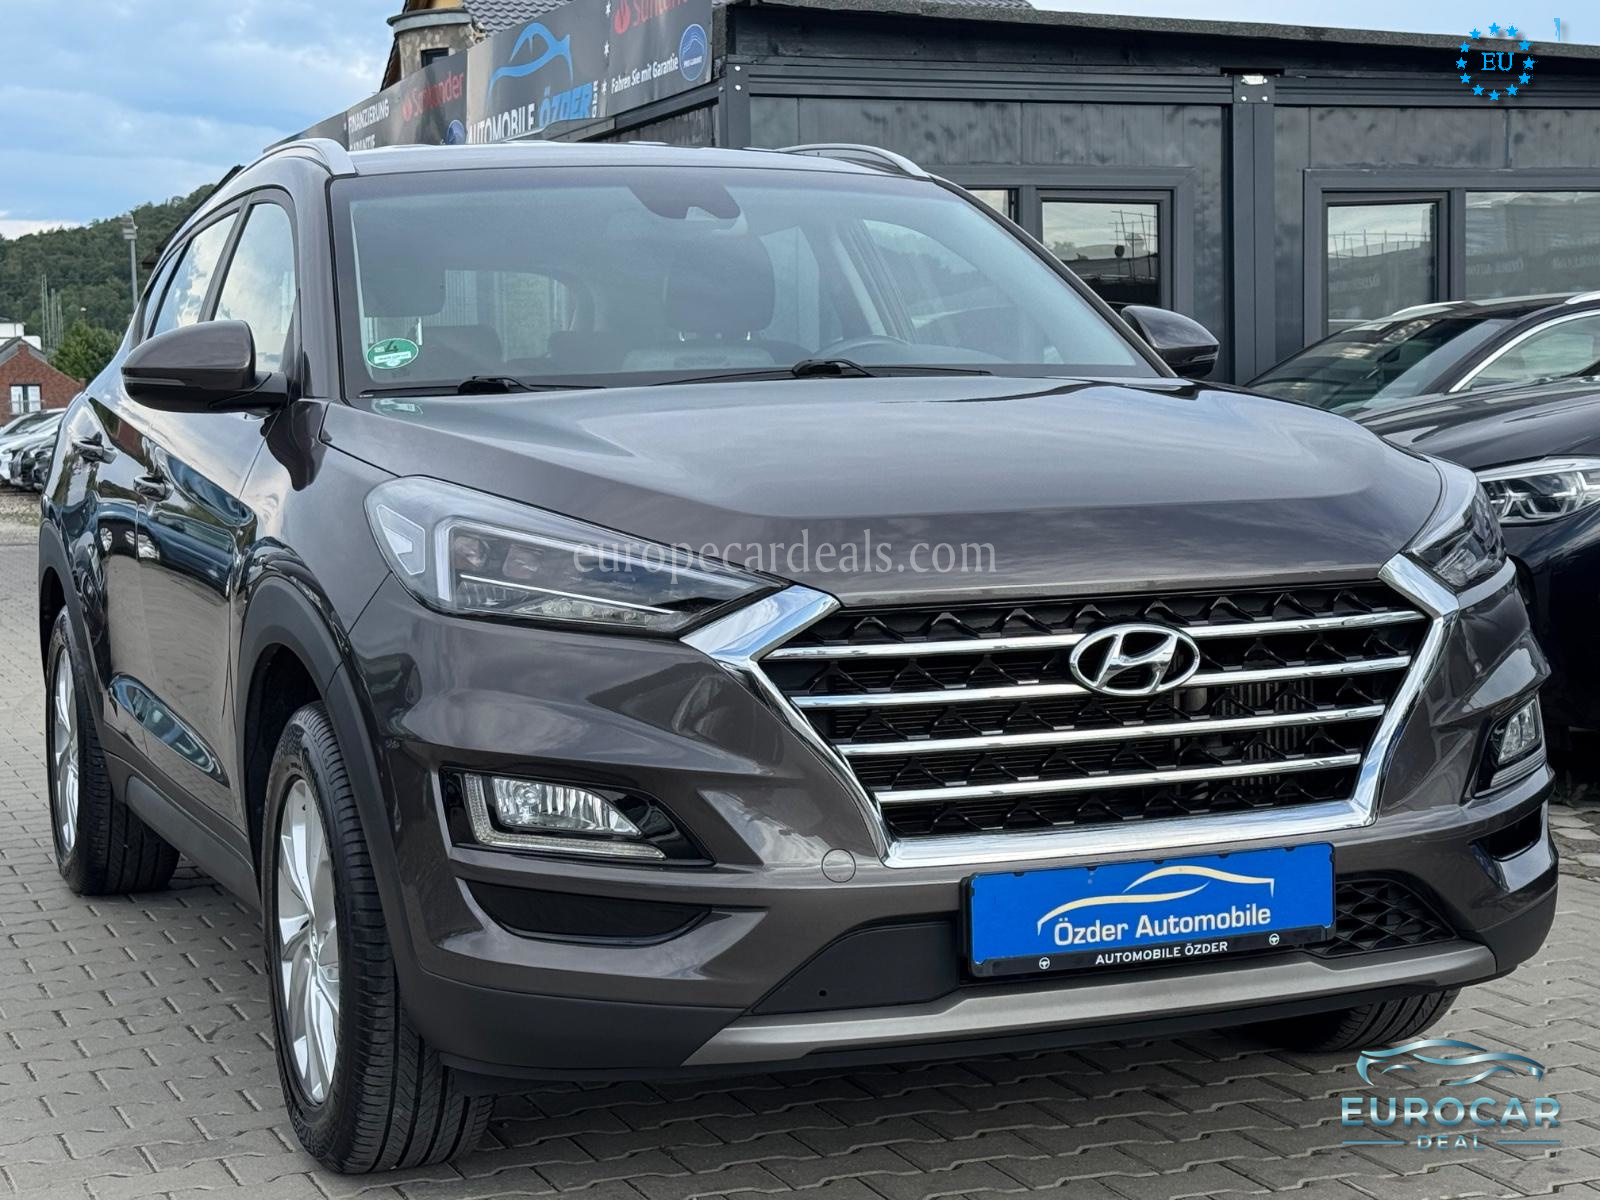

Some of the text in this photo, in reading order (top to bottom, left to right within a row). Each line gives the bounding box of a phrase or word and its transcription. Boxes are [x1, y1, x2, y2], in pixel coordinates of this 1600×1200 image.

[611, 74, 631, 94] Fahren
[631, 68, 641, 86] Sie
[641, 63, 652, 83] mit
[652, 53, 679, 78] Garantie
[348, 98, 390, 133] FINANZIERUNG
[468, 103, 535, 144] AUTOMOBILE
[1054, 903, 1271, 946] Özder Automobile
[1096, 940, 1228, 965] AUTOMOBILE ÖZDER
